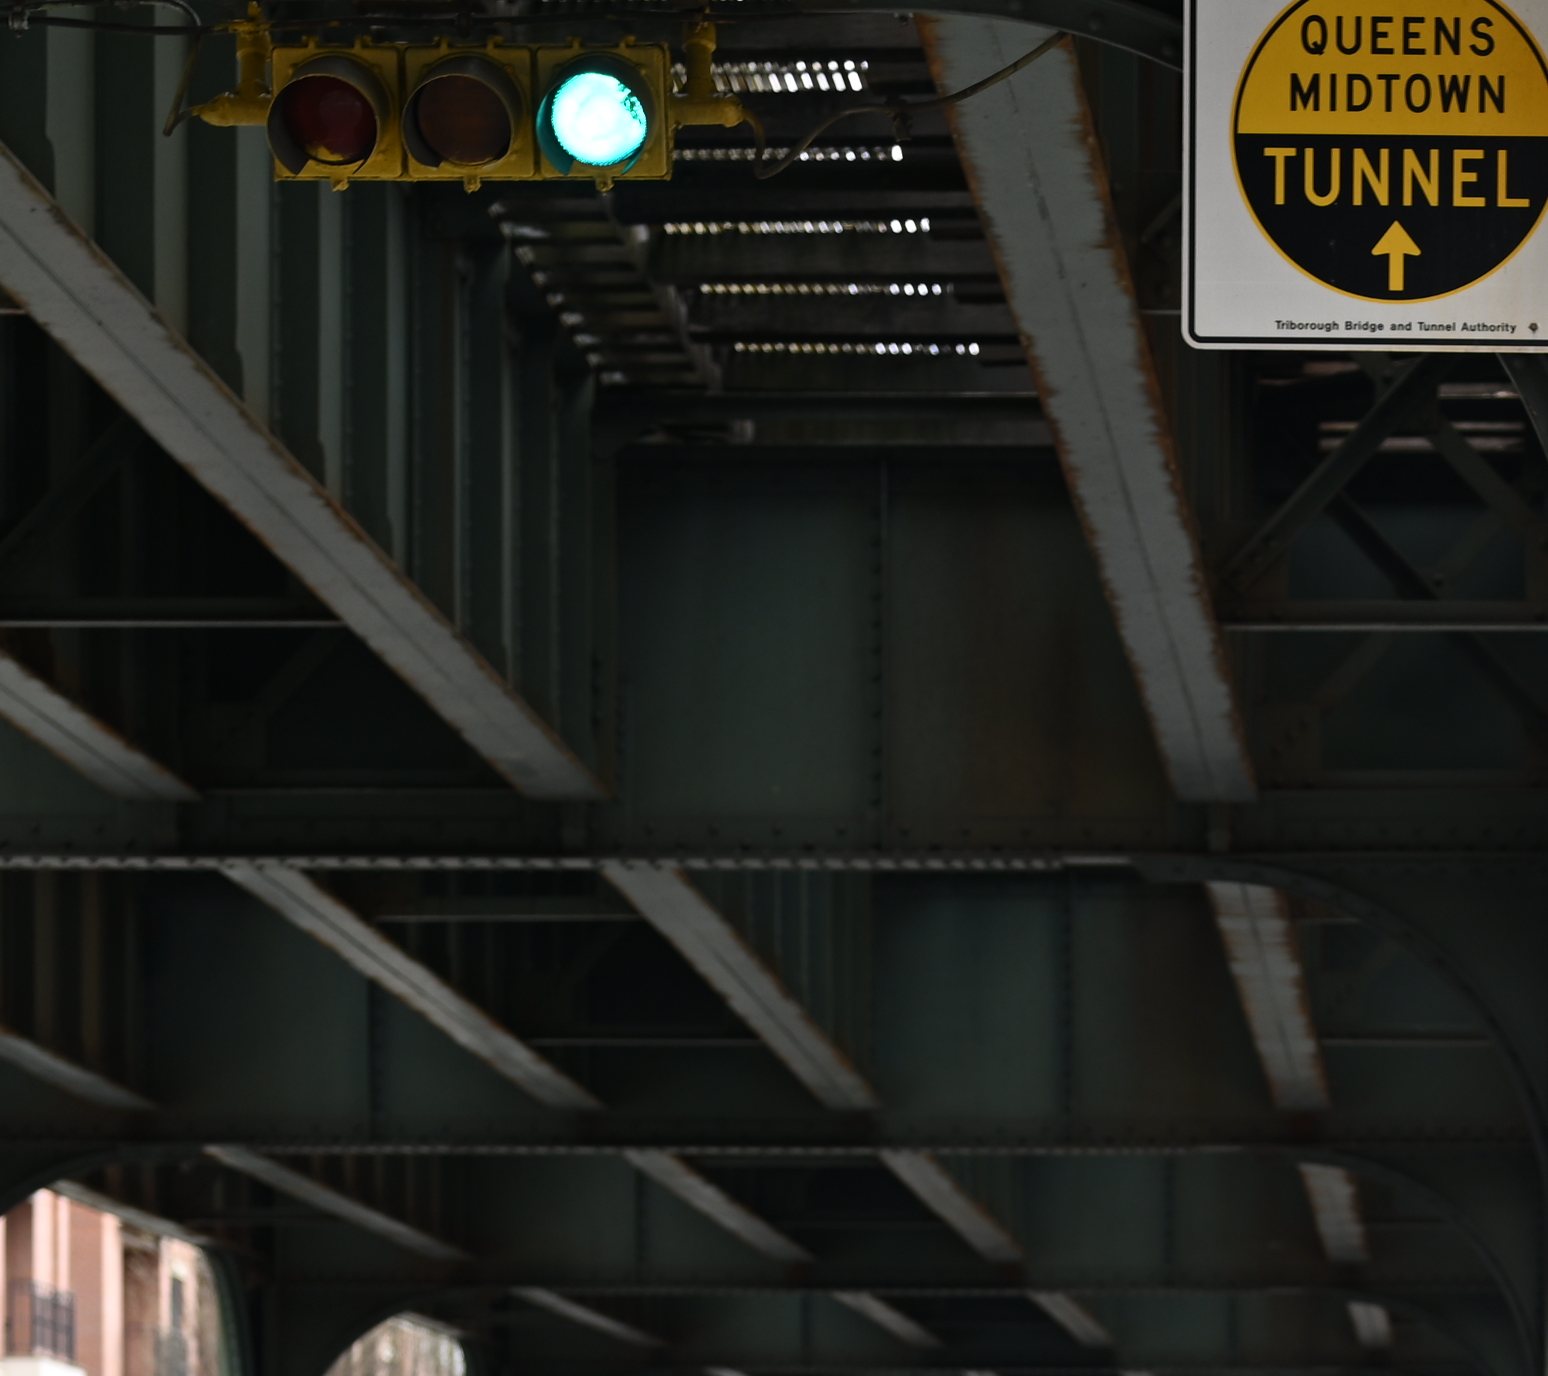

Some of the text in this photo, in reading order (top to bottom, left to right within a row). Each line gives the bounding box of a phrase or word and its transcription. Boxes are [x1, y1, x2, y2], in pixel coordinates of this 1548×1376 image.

[1301, 14, 1495, 57] QUEENS
[1289, 72, 1506, 114] MIDTOWN
[1263, 147, 1530, 207] TUNNEL
[1275, 320, 1517, 333] Triborough Bridge and Tunnel Authority
